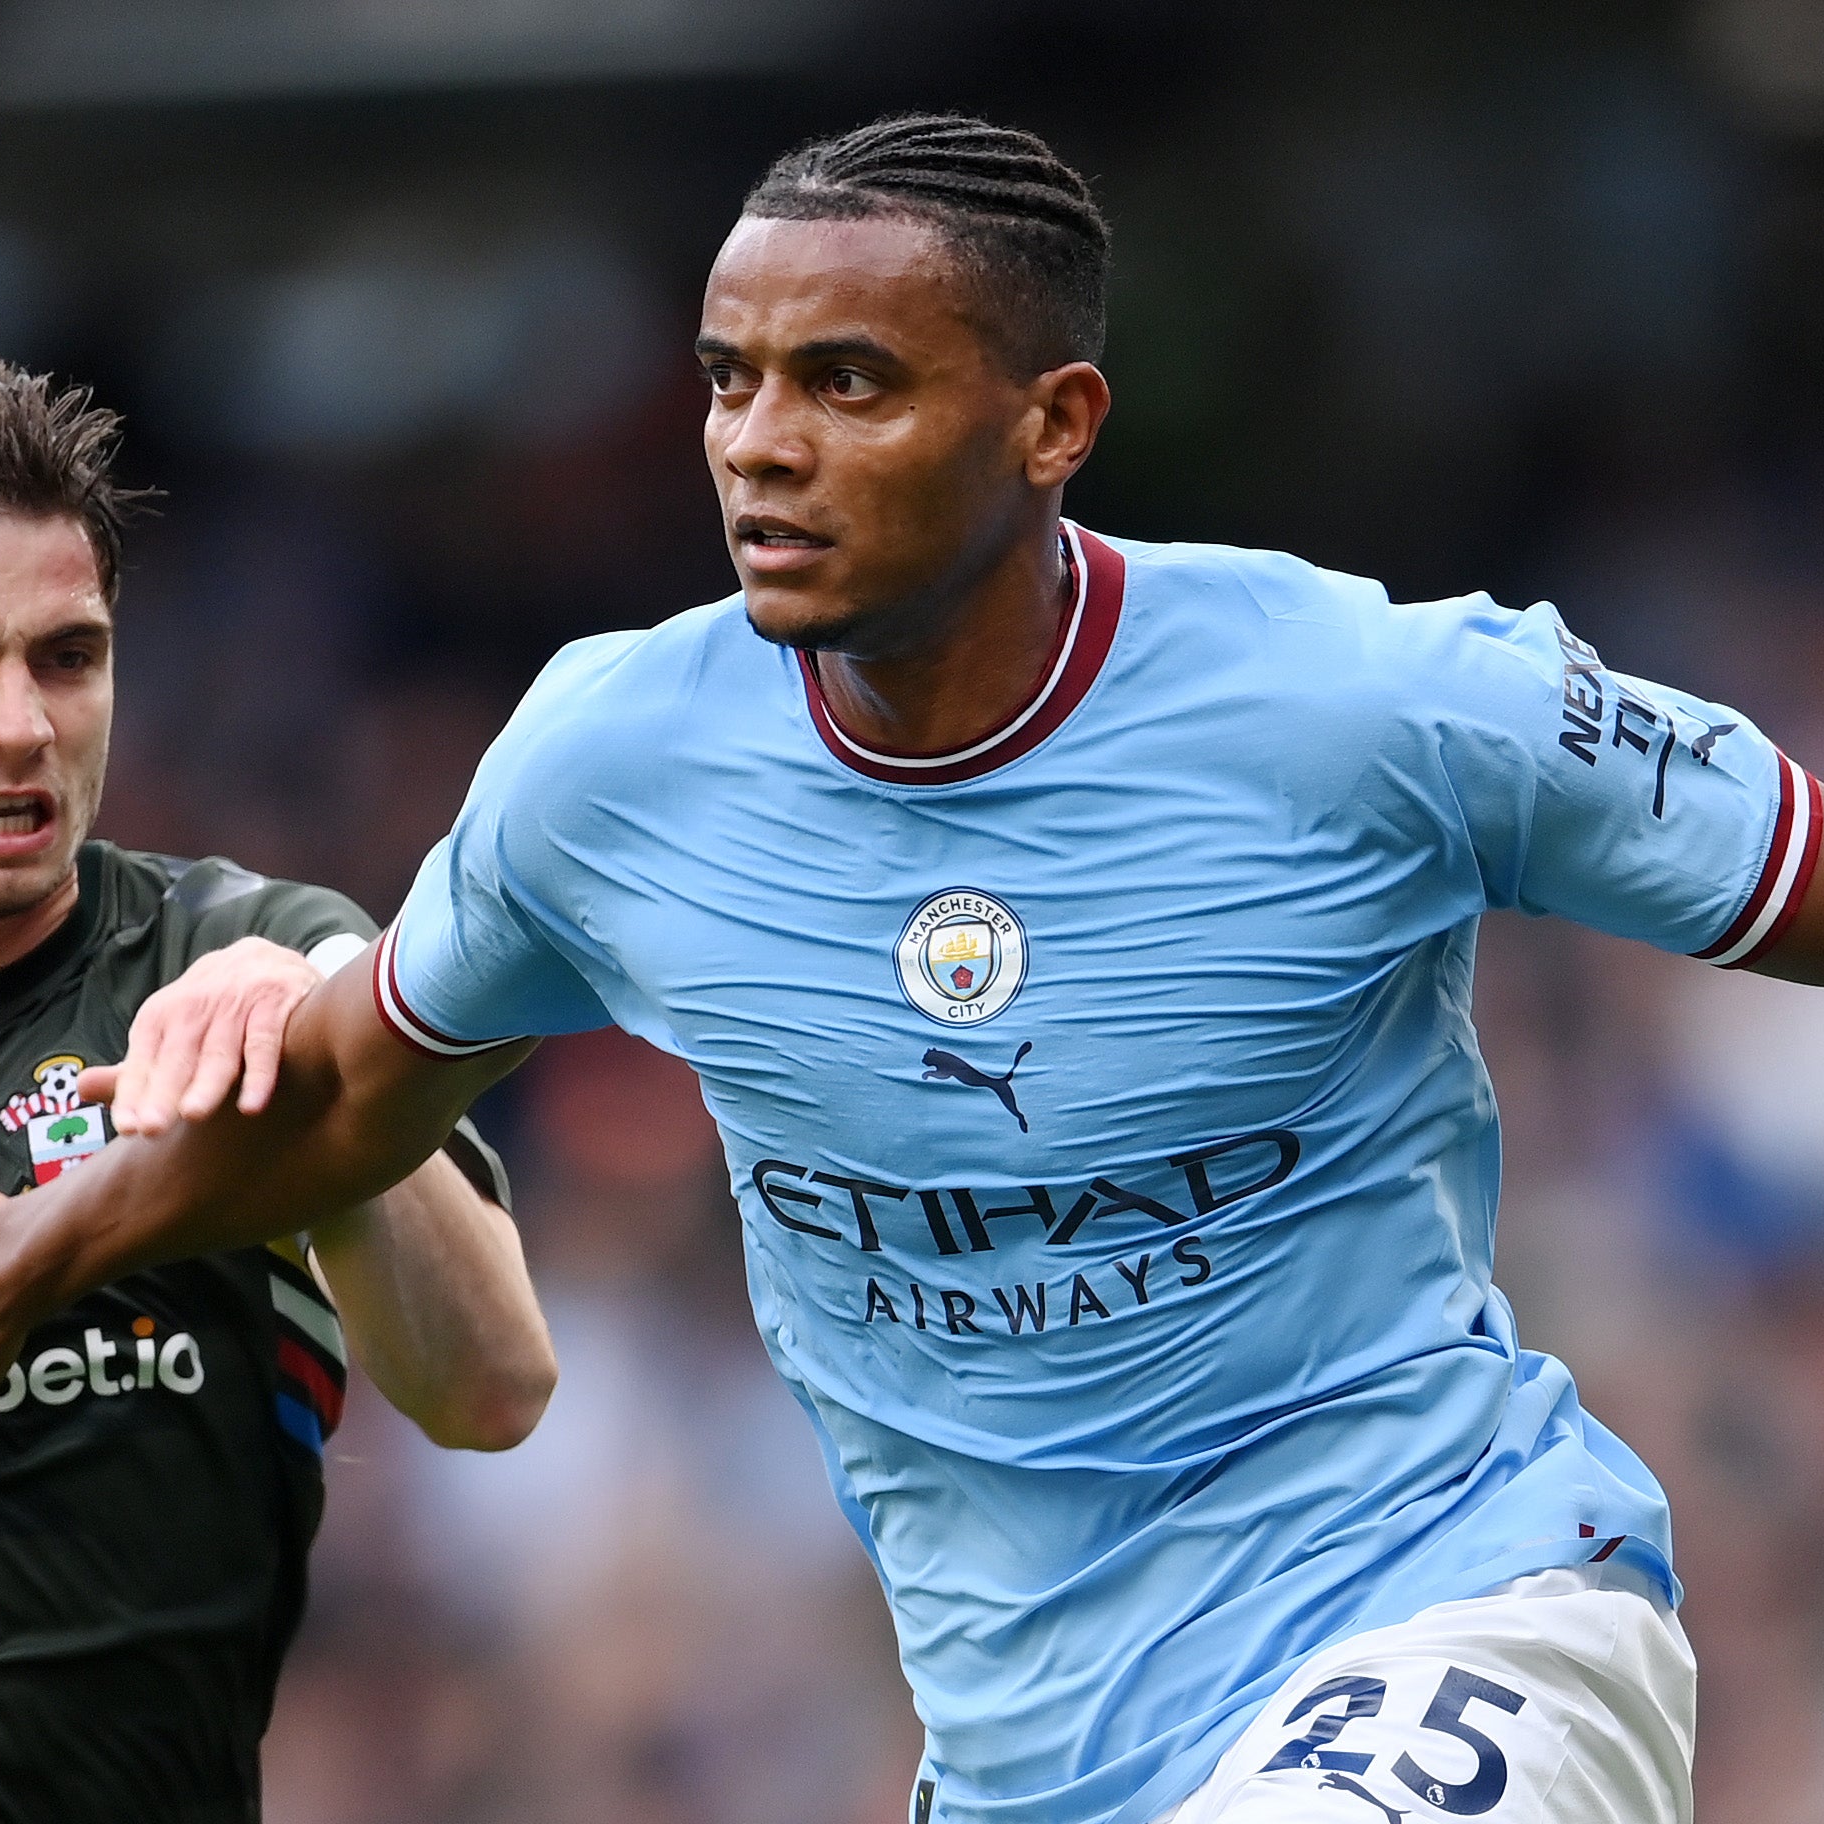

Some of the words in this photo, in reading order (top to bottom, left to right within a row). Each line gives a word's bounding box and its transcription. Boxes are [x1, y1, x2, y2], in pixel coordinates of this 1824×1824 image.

[1553, 619, 1603, 767] NEXE
[908, 897, 1012, 944] MANCHESTER
[947, 1002, 986, 1018] CITY
[750, 1128, 1301, 1256] ETIHAD
[864, 1236, 1211, 1335] AIRWAYS
[1254, 1665, 1527, 1816] 25
